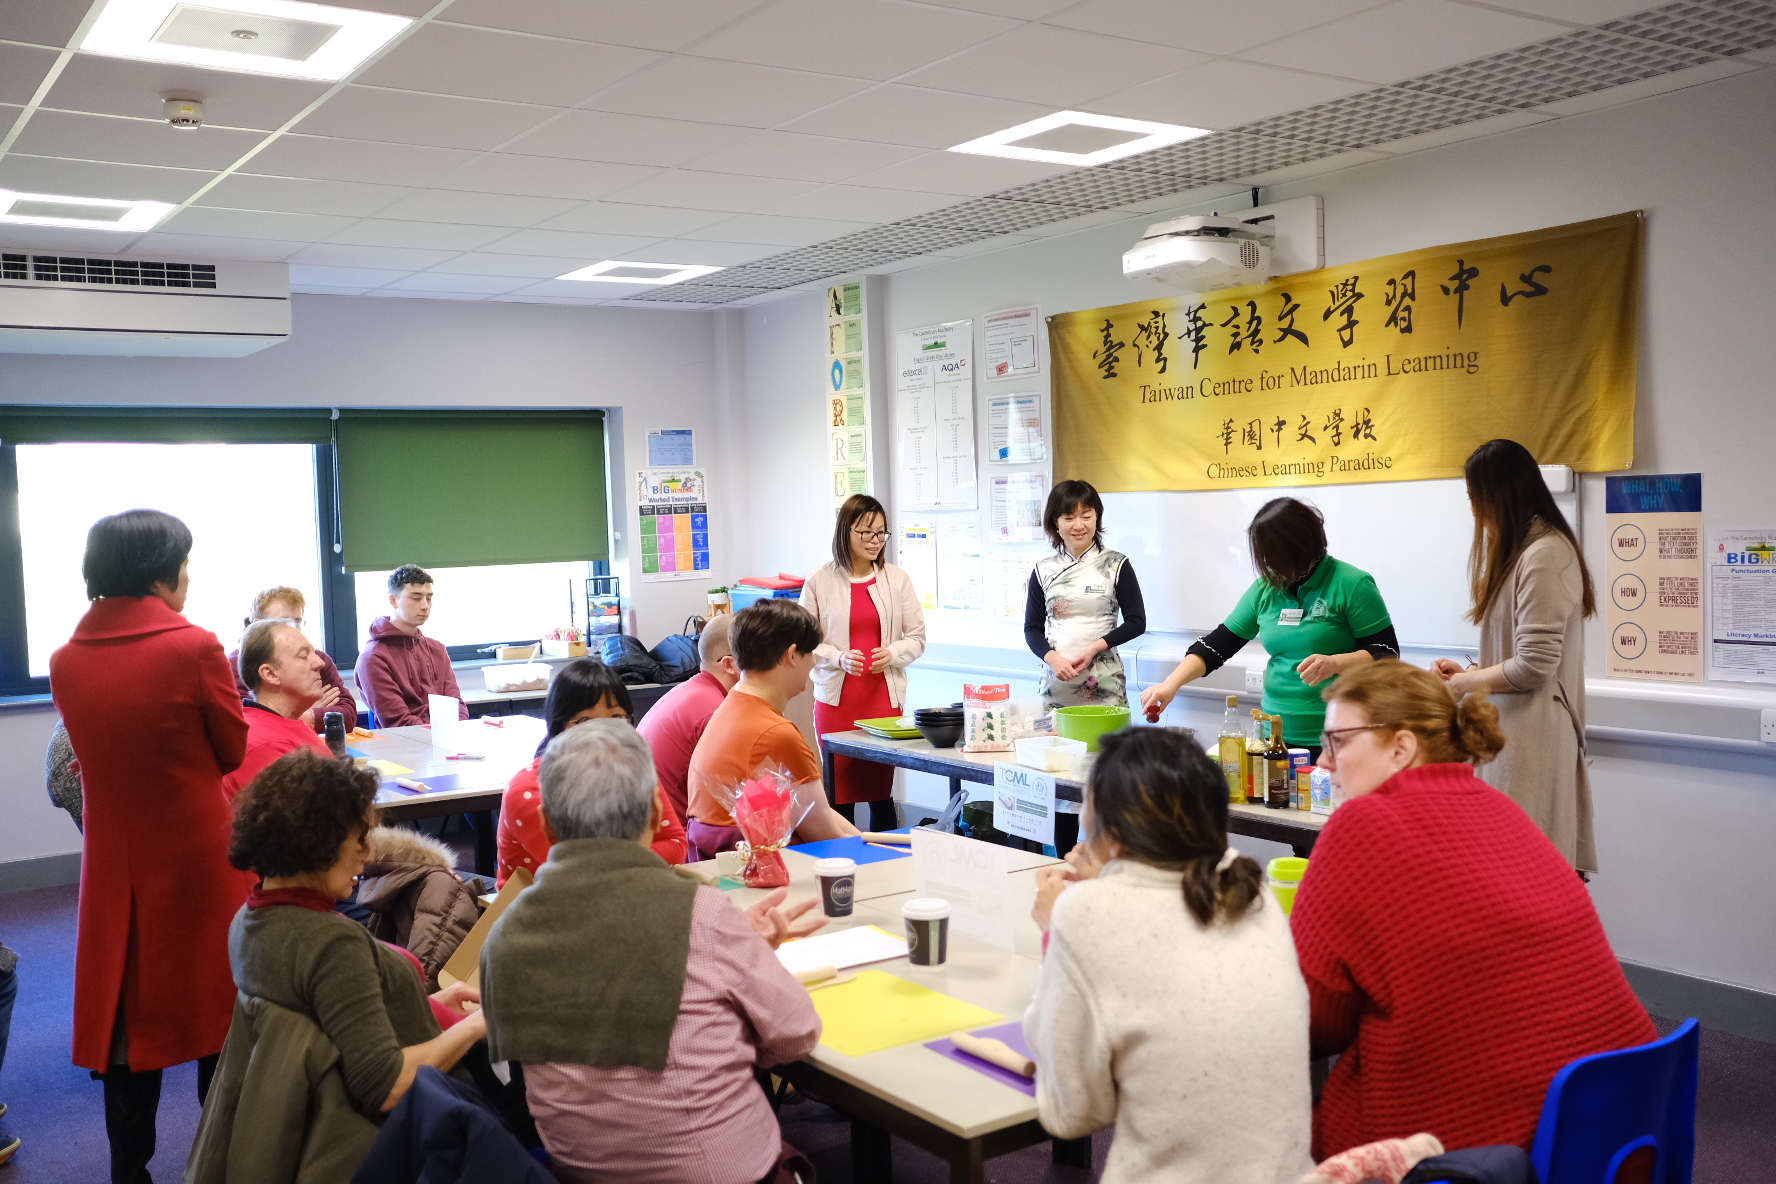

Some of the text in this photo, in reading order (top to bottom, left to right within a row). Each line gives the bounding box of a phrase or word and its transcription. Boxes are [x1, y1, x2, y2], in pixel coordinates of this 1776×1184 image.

[1093, 264, 1553, 379] 臺灣華語文學習中心
[941, 362, 960, 373] AQA
[1139, 346, 1479, 405] Taiwan Centre for Mandarin Learning
[1216, 407, 1377, 455] 華園中文學校
[1206, 452, 1392, 480] Chinese Learning Paradise
[1622, 478, 1684, 495] WHAT, HOW,
[672, 495, 698, 503] Examples
[1641, 495, 1664, 510] WHY
[1618, 537, 1638, 547] WHAT
[1727, 552, 1760, 564] BiG
[1620, 587, 1637, 597] HOW
[1659, 596, 1698, 604] EXPRESSED?
[1620, 636, 1637, 646] WHY
[1000, 767, 1030, 787] TCML
